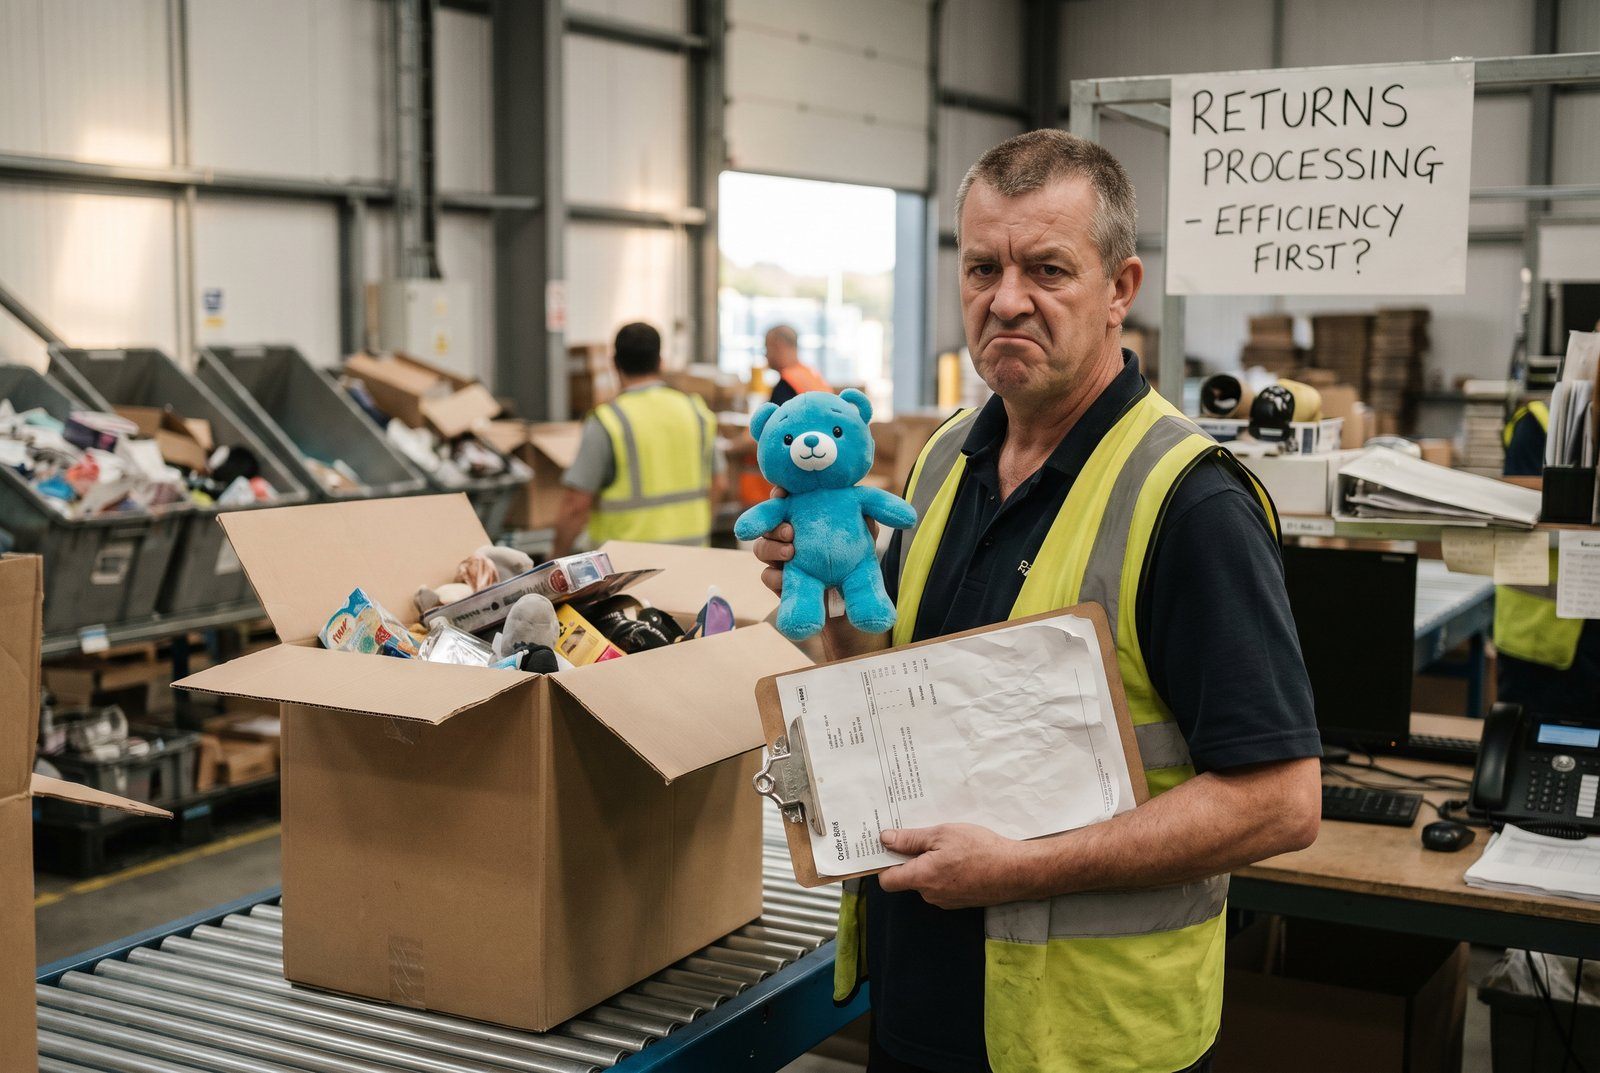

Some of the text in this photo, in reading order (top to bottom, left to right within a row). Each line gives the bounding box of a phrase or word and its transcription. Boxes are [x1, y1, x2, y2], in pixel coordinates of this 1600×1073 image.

[1192, 84, 1408, 135] RETURNS
[1203, 145, 1444, 185] PROCESSING
[1214, 203, 1404, 237] EFFICIENCY
[1254, 238, 1371, 275] FIRST?
